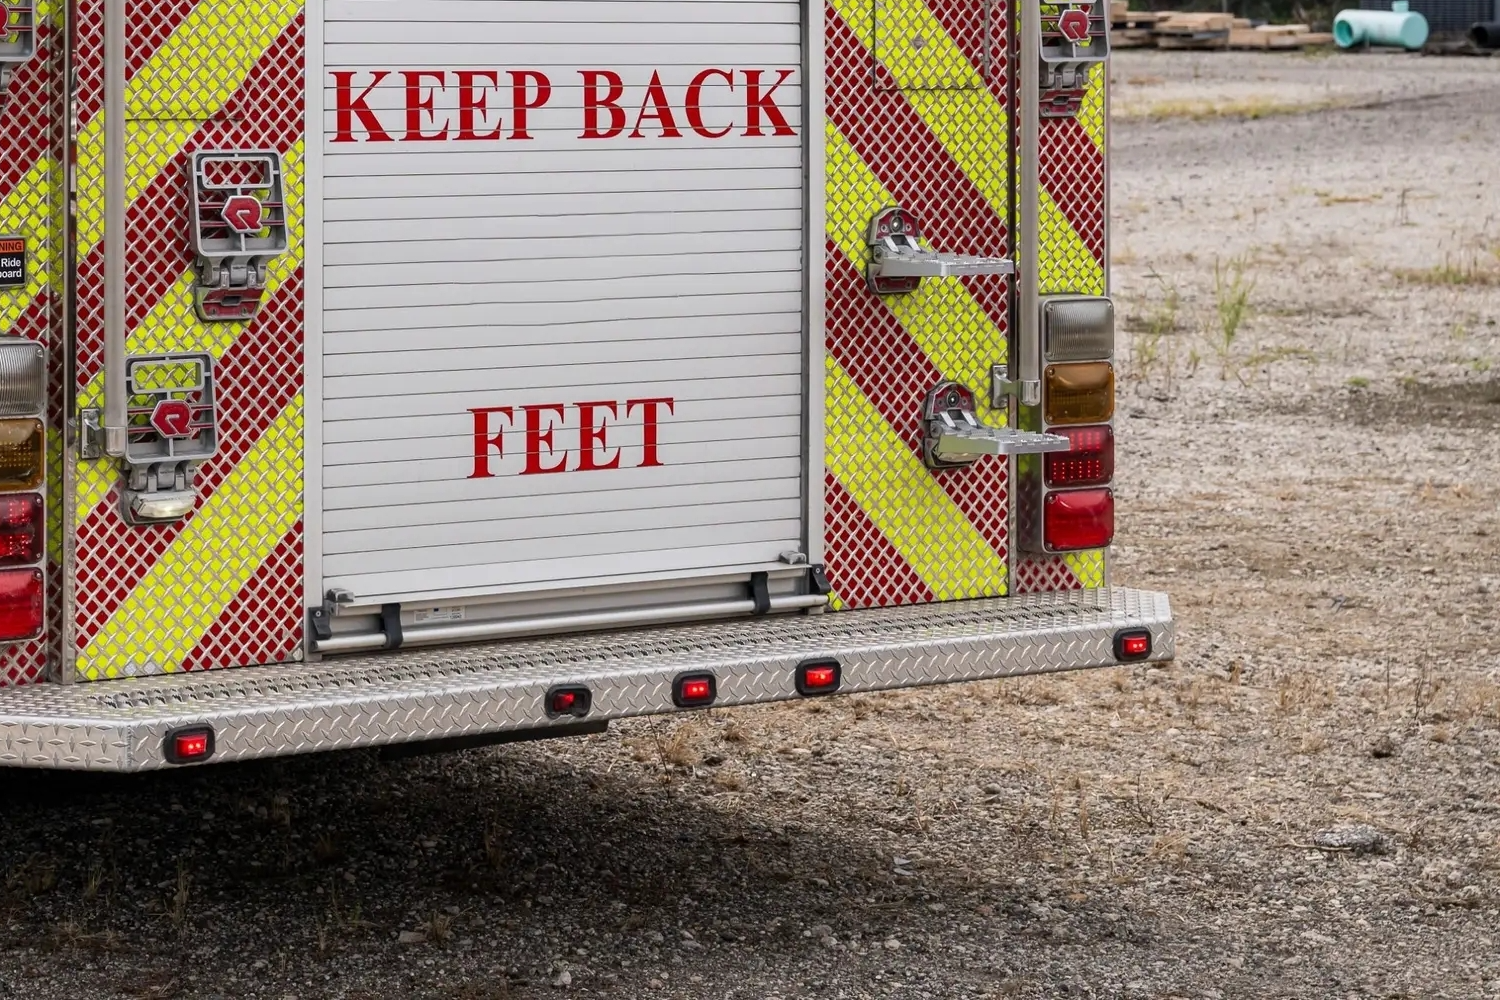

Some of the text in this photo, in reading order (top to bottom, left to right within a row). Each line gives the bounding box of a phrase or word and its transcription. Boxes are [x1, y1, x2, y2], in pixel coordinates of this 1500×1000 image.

[329, 67, 797, 143] KEEP BACK
[1, 258, 21, 267] Ride
[467, 396, 675, 479] FEET
